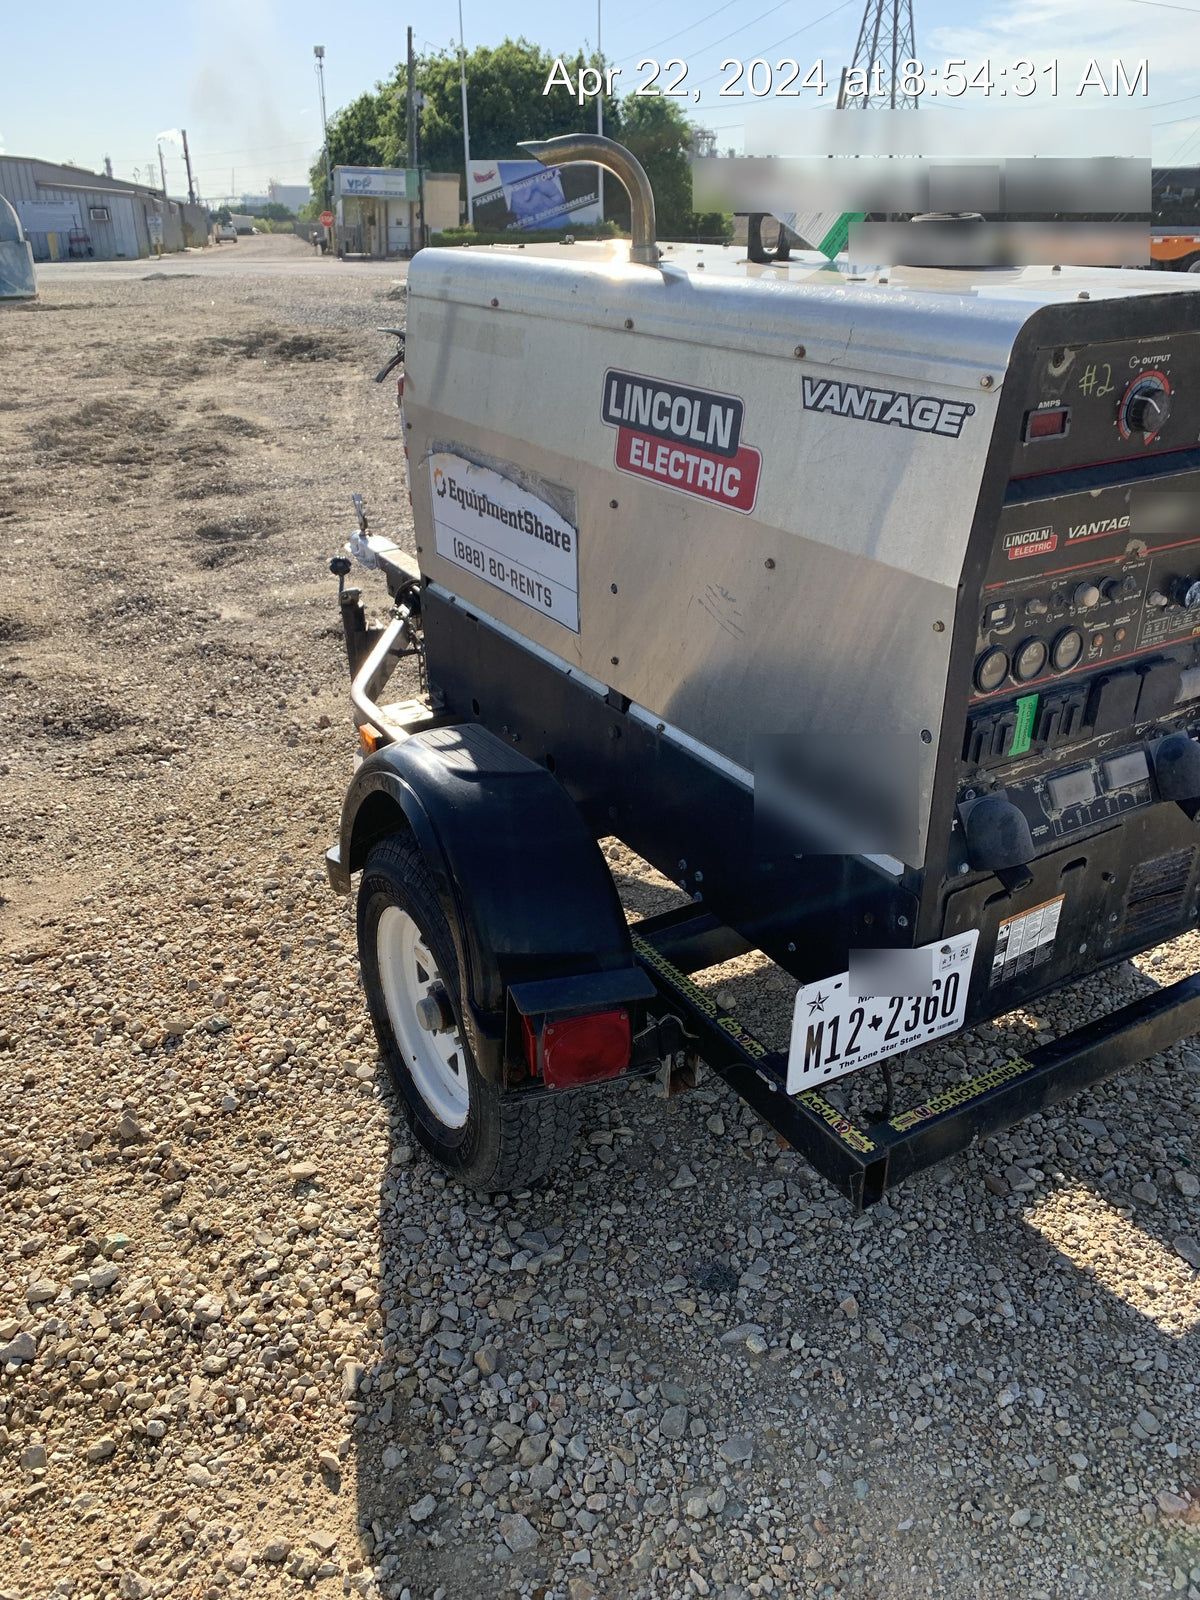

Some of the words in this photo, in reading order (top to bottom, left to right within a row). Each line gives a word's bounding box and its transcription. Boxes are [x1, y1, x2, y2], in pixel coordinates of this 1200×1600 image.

[476, 178, 534, 206] PARTNSHIP
[535, 192, 596, 220] ENVIRONMENT
[1142, 354, 1171, 364] OUTPUT
[1079, 365, 1114, 397] #2
[608, 380, 734, 449] LINCOLN
[1038, 400, 1061, 409] AMPS
[629, 437, 741, 498] ELECTRIC
[447, 477, 571, 553] EquipmentShare
[1068, 515, 1130, 539] VANTAG
[1005, 528, 1050, 548] LINCOLN
[1014, 541, 1052, 557] ELECTRIC
[453, 537, 485, 573] (888)
[488, 558, 552, 608] 80-RENTS
[949, 952, 956, 961] 11
[645, 950, 661, 966] PAS
[660, 961, 688, 988] TENEZ
[687, 988, 718, 1016] DEBOU
[722, 1019, 738, 1032] ICI
[803, 1007, 865, 1073] M12
[884, 972, 960, 1042] 2360
[746, 1042, 763, 1057] NO
[839, 1058, 855, 1070] The
[857, 1049, 878, 1063] Lone
[880, 1042, 898, 1053] Star
[900, 1033, 922, 1046] State
[930, 1099, 950, 1112] DO
[950, 1086, 977, 1102] NOT
[977, 1067, 1017, 1088] STAND
